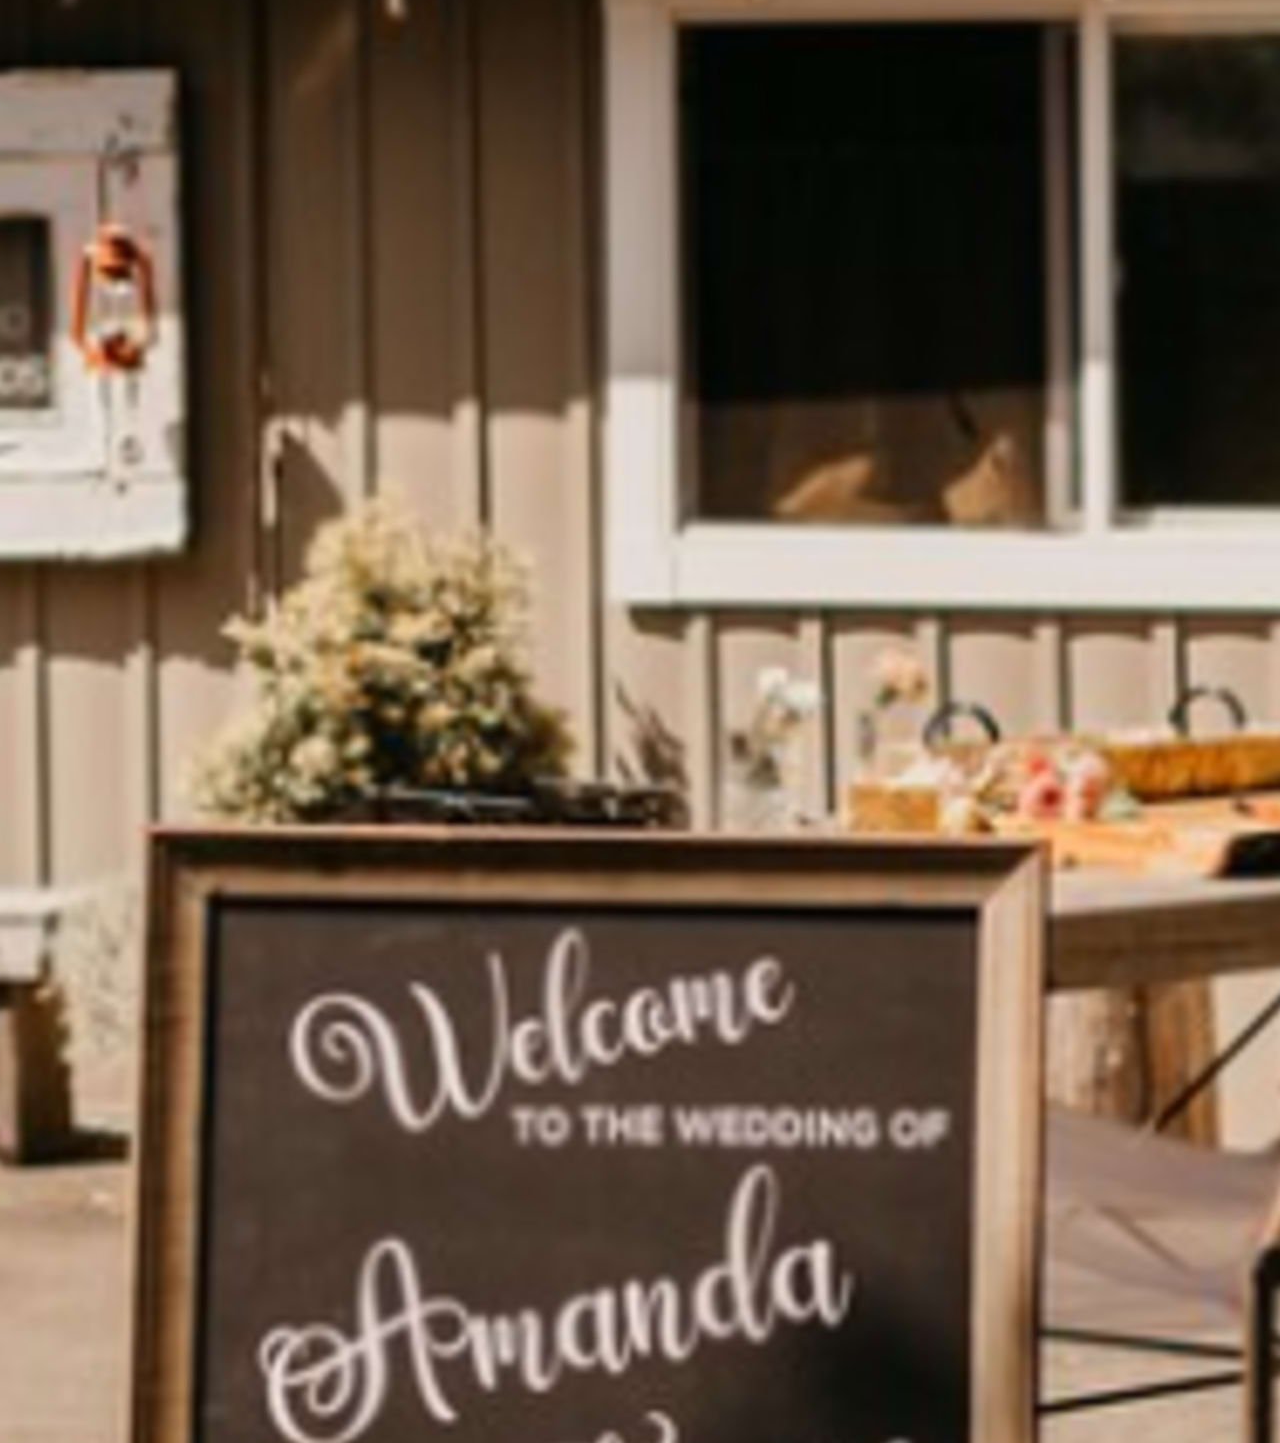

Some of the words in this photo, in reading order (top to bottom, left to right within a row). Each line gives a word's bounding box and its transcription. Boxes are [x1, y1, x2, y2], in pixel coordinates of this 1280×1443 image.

[288, 927, 793, 1130] Welcome
[513, 1105, 570, 1147] TO
[580, 1105, 663, 1149] THE
[673, 1105, 881, 1149] WEDDING
[887, 1107, 952, 1150] OF
